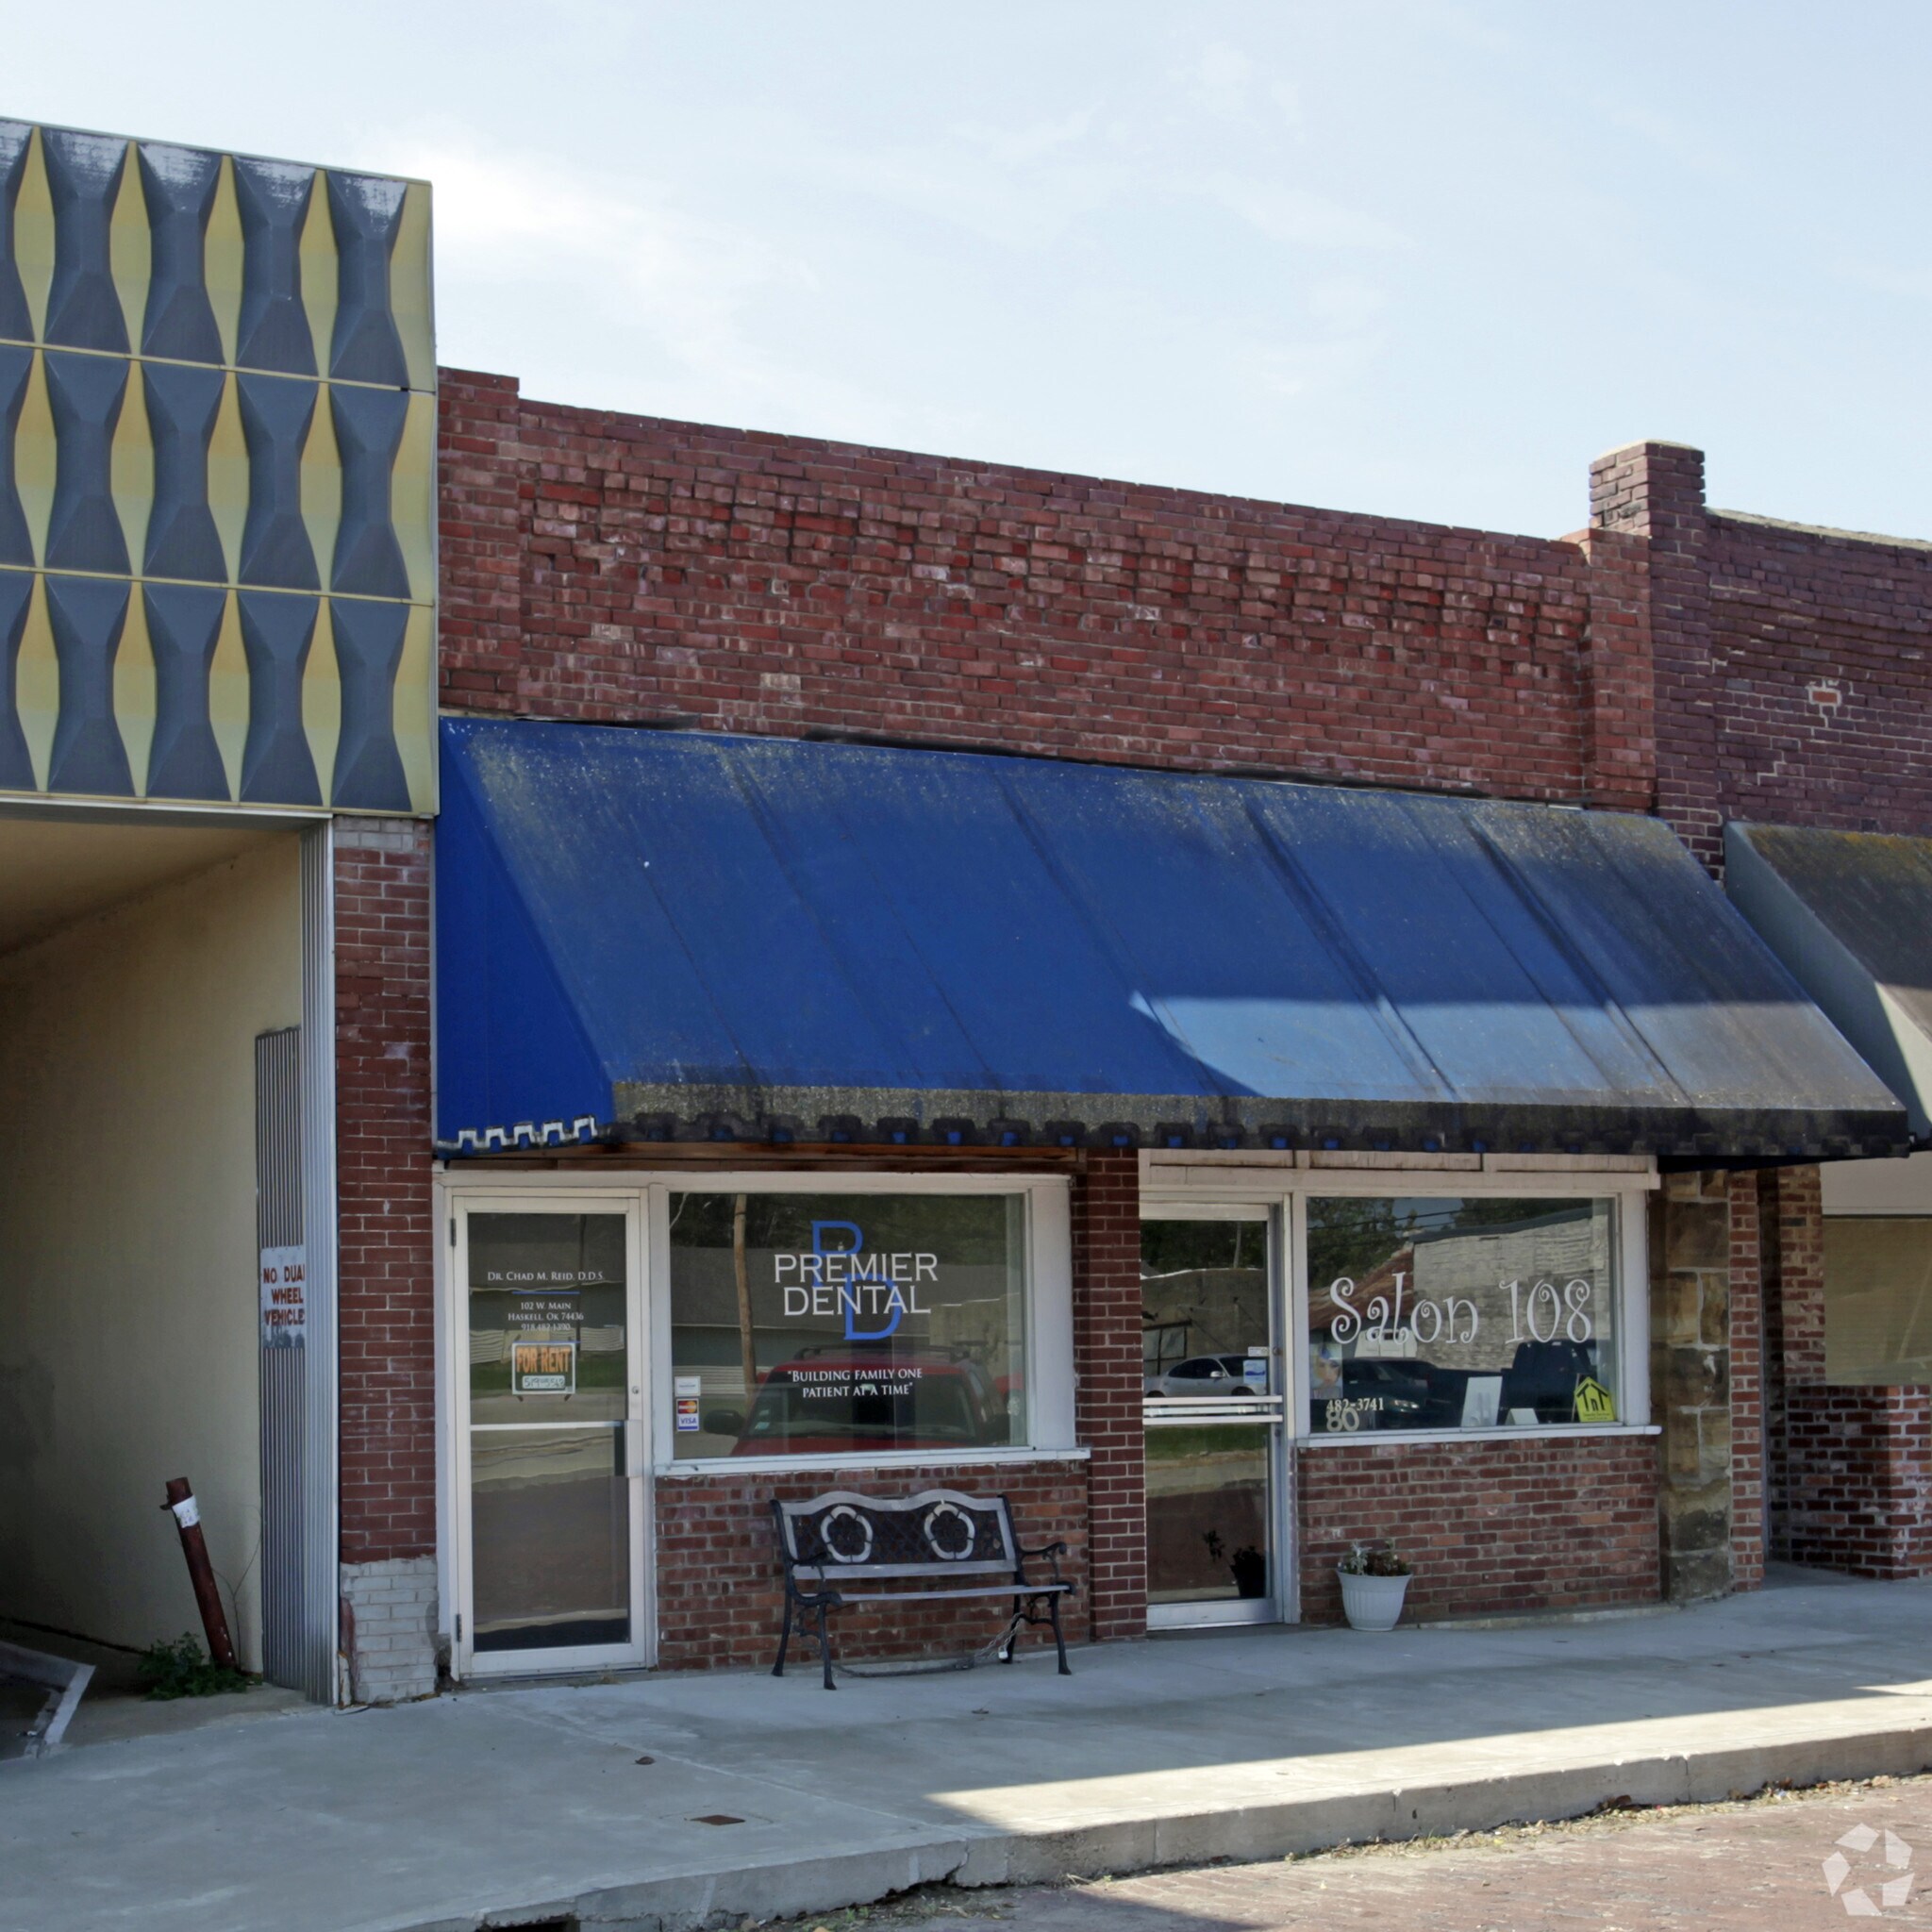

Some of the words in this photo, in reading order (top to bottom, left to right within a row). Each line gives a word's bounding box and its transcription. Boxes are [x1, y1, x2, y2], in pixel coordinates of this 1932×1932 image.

[263, 1267, 277, 1284] NO
[774, 1252, 939, 1283] PREMIER
[506, 1272, 534, 1281] CHAD
[272, 1287, 304, 1305] WHEEL
[784, 1286, 931, 1316] DENTAL
[521, 1302, 534, 1310] 102
[1329, 1272, 1479, 1345] Salon
[1499, 1278, 1592, 1344] 108
[516, 1346, 538, 1373] FOR
[541, 1346, 571, 1373] RENT
[854, 1369, 895, 1381] FAMILY
[898, 1368, 923, 1379] ONE
[803, 1386, 850, 1398] PATIENT
[853, 1385, 868, 1396] AT
[870, 1385, 878, 1395] A
[1325, 1397, 1385, 1411] 482-3741
